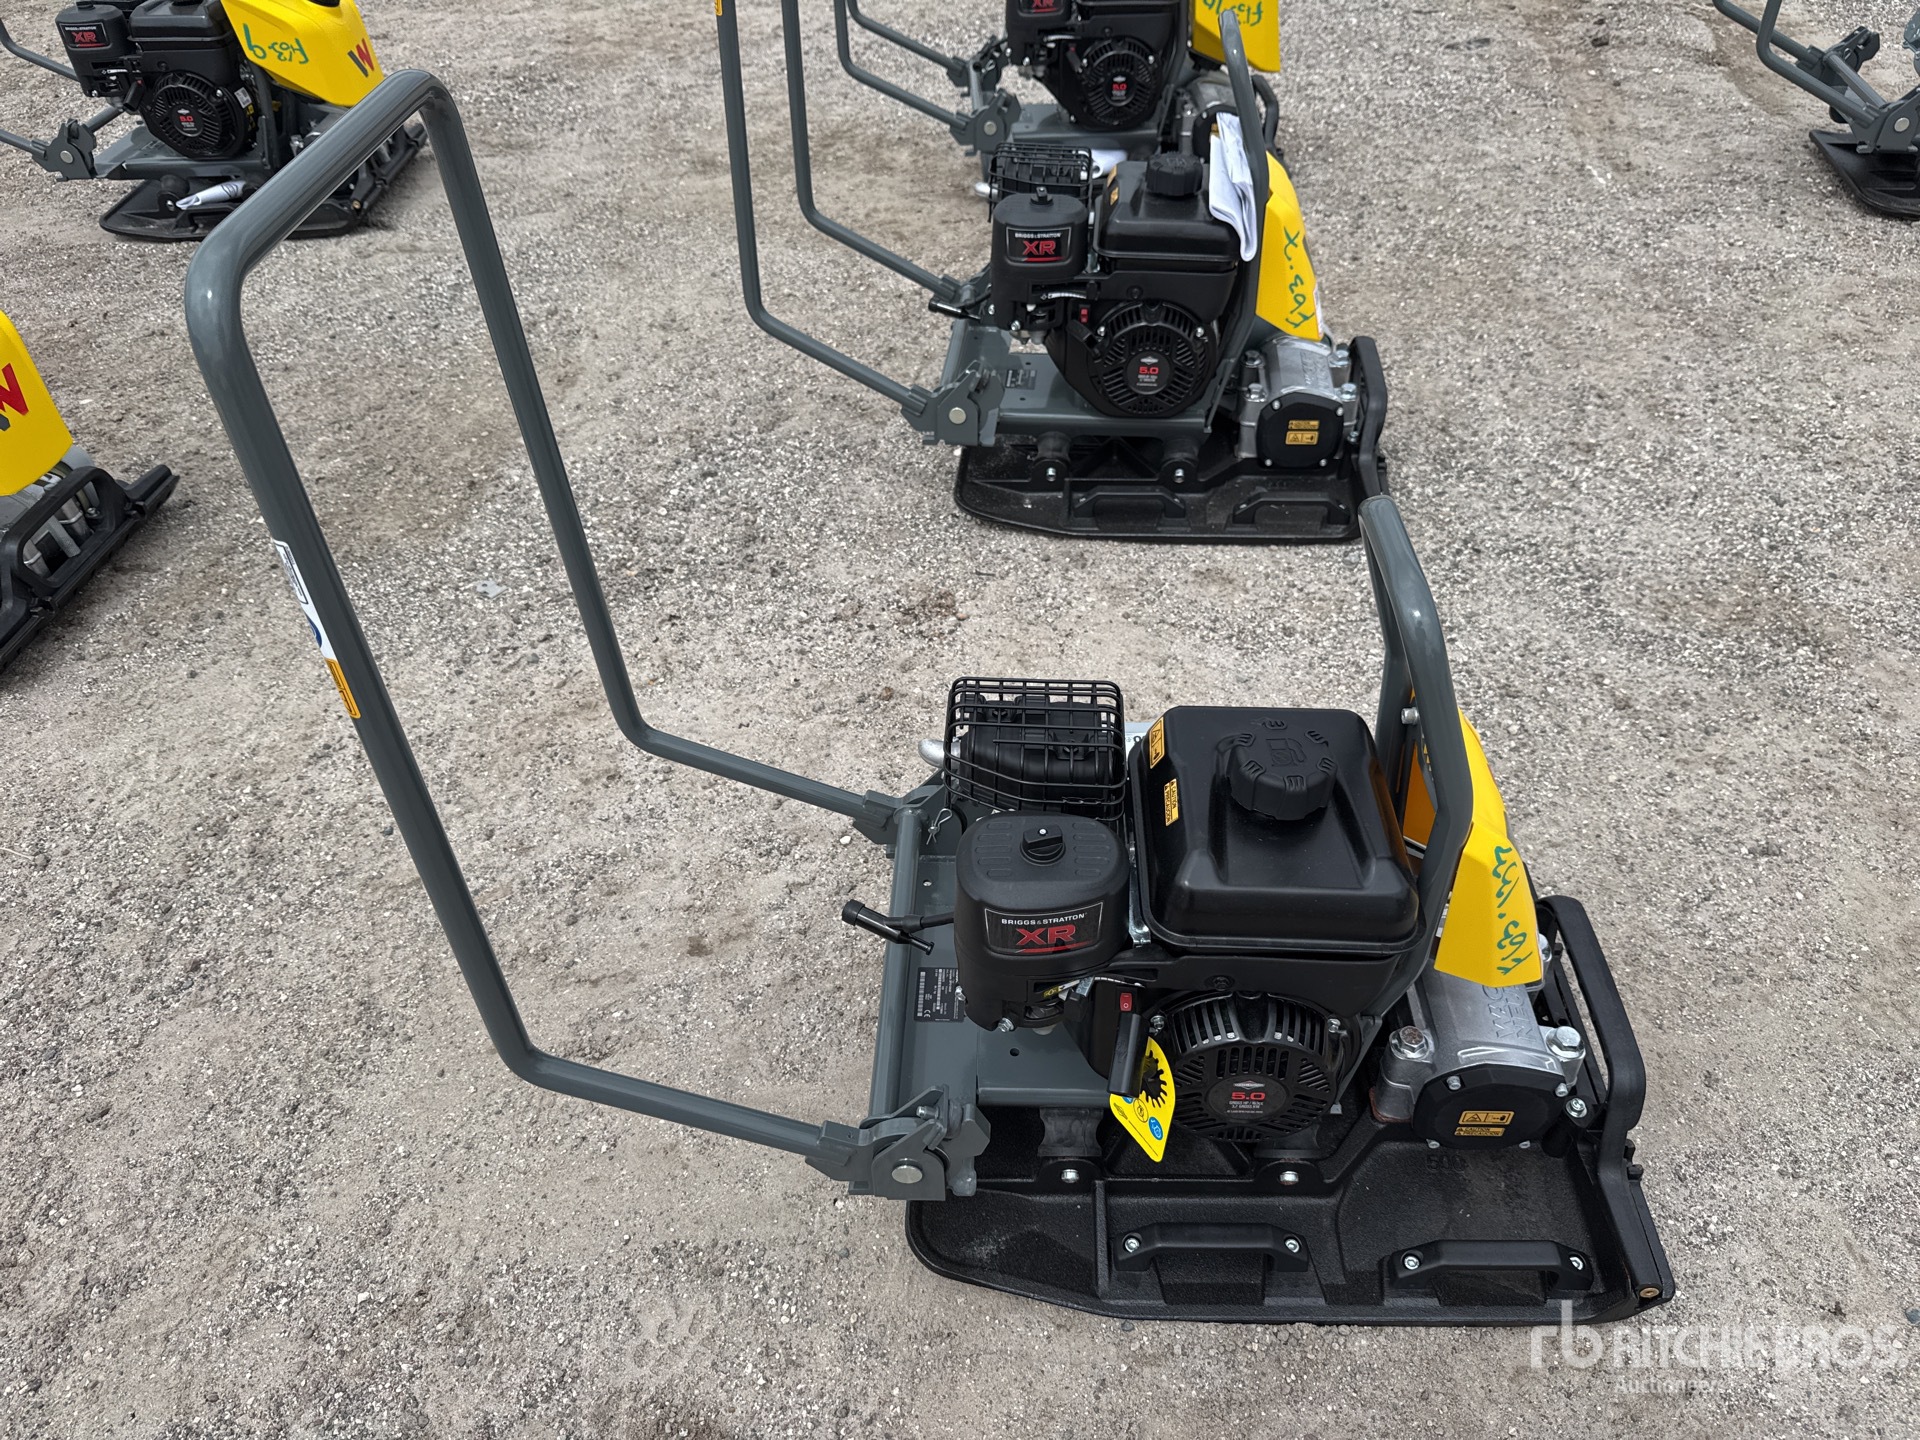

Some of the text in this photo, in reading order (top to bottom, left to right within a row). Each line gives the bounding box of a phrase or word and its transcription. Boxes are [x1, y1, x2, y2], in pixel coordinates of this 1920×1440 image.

[71, 31, 97, 43] XR
[1022, 240, 1057, 255] XR
[1139, 366, 1159, 375] 5.0
[1015, 924, 1076, 946] XR
[1231, 1091, 1266, 1100] 5.0
